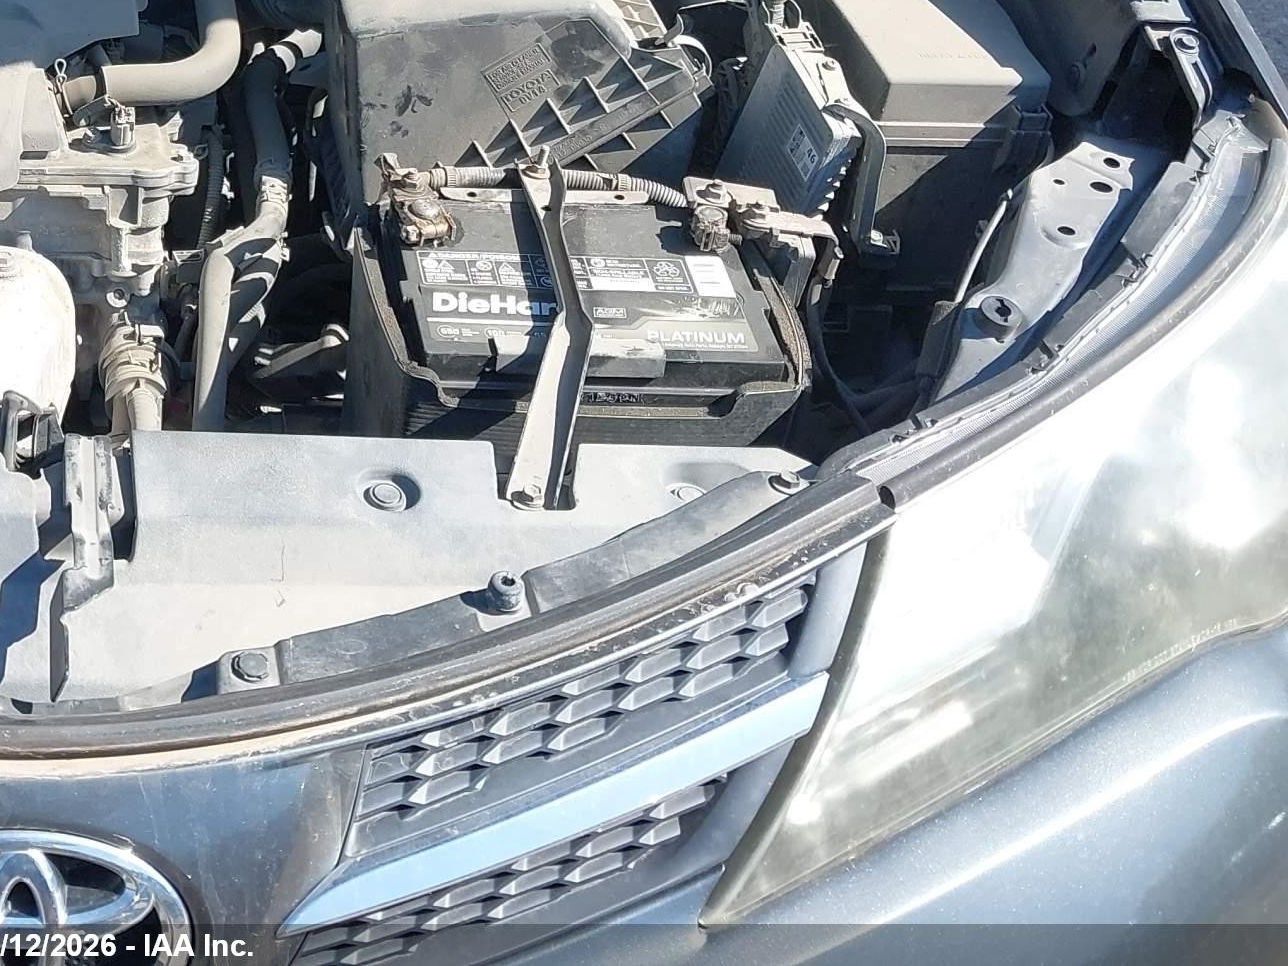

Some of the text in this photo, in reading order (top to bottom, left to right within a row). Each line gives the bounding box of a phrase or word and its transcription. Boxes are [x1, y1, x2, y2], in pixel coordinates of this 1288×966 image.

[503, 71, 550, 102] TOYOTA
[806, 147, 816, 163] 46
[433, 291, 557, 315] DieHar
[647, 330, 745, 344] PLATINUM
